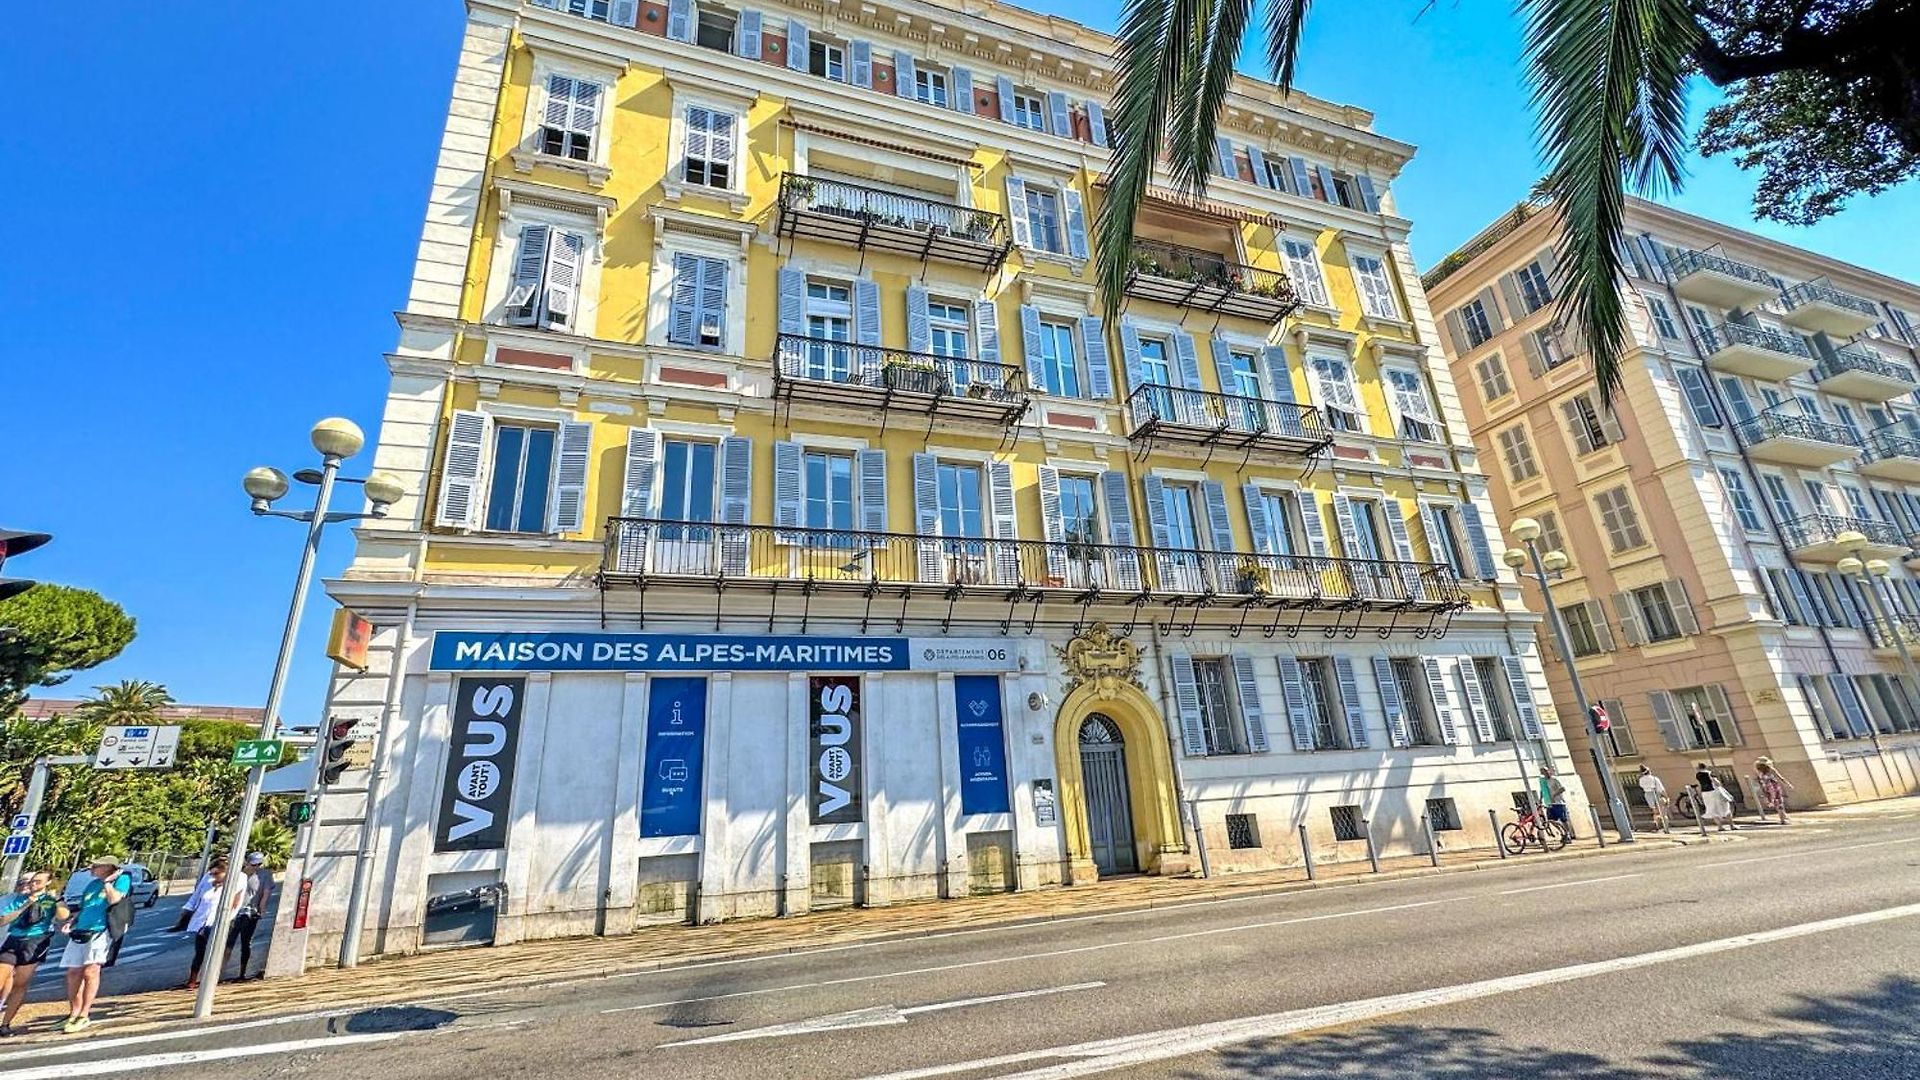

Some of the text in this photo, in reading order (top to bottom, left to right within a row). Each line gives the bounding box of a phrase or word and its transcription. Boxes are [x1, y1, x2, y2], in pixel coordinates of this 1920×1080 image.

[455, 641, 893, 663] MAISON DES ALPES-MARITIMES
[987, 648, 1005, 660] 06
[448, 684, 514, 842] VOUS
[818, 684, 853, 817] VOUS
[468, 763, 481, 798] AVANT
